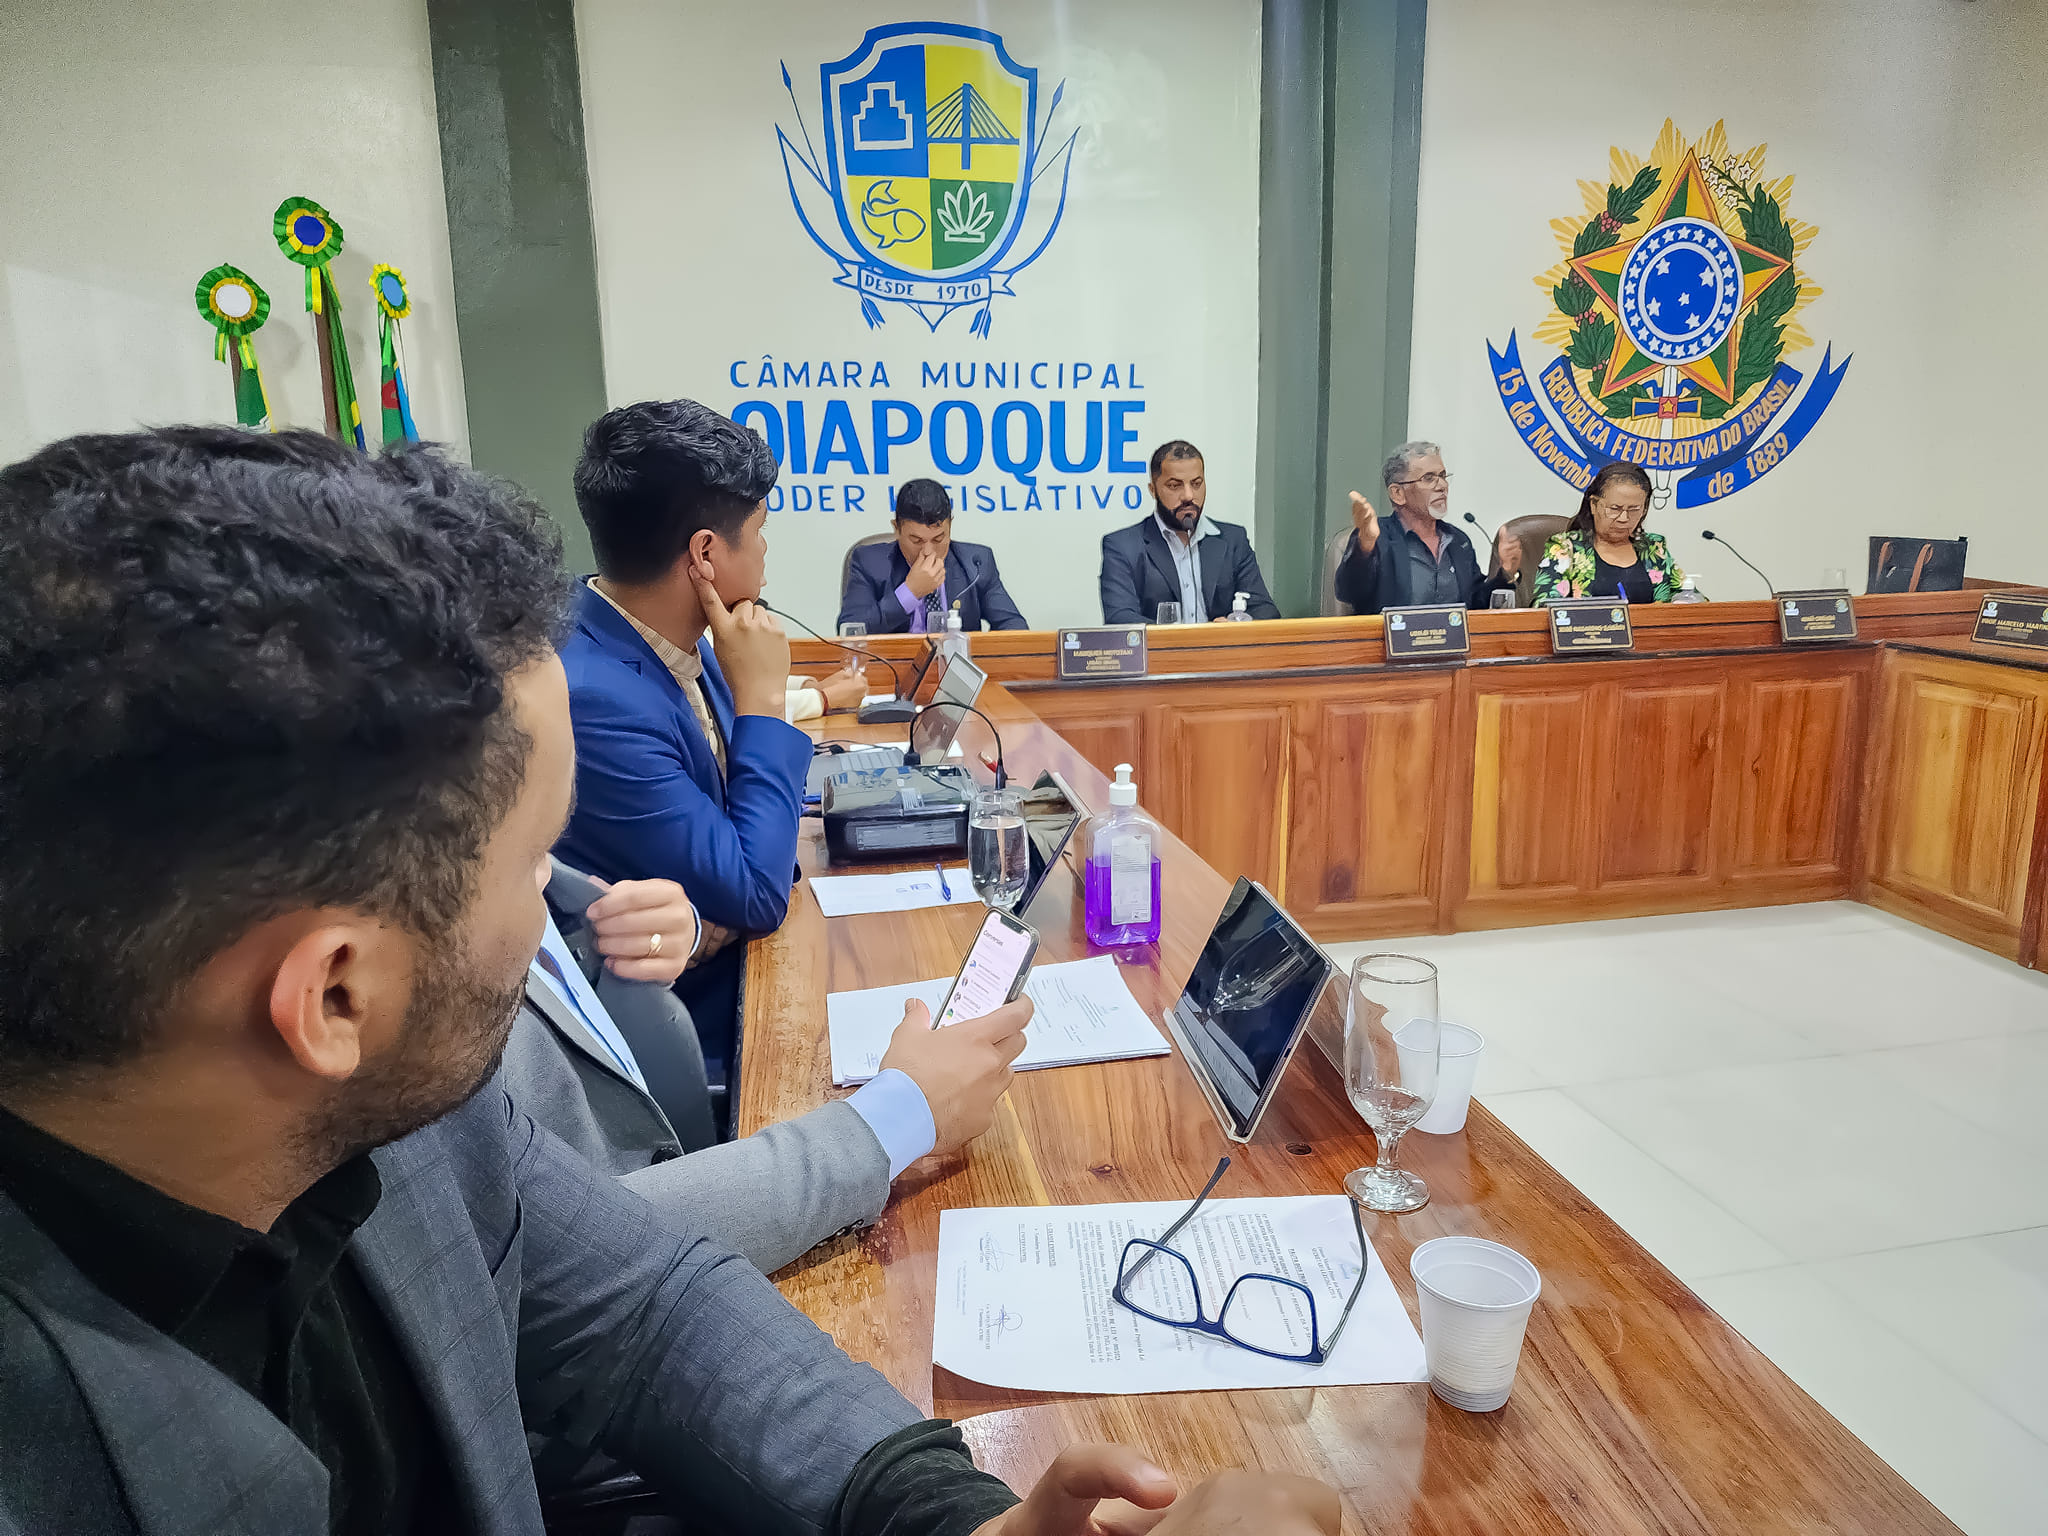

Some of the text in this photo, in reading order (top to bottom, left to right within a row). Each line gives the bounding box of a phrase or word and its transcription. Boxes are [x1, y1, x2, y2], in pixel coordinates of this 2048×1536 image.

[865, 274, 981, 300] DESDE 1970
[729, 354, 1145, 390] CÂMARA MUNICIPAL
[730, 400, 1147, 486] OIAPOQUE
[1498, 367, 1789, 499] 15 de Novemb de 1889
[1610, 433, 1719, 467] FEDERATIVA
[1720, 423, 1742, 452] DO
[1741, 378, 1796, 437] BRASIL
[766, 484, 1142, 513] ODER LISLATIVO
